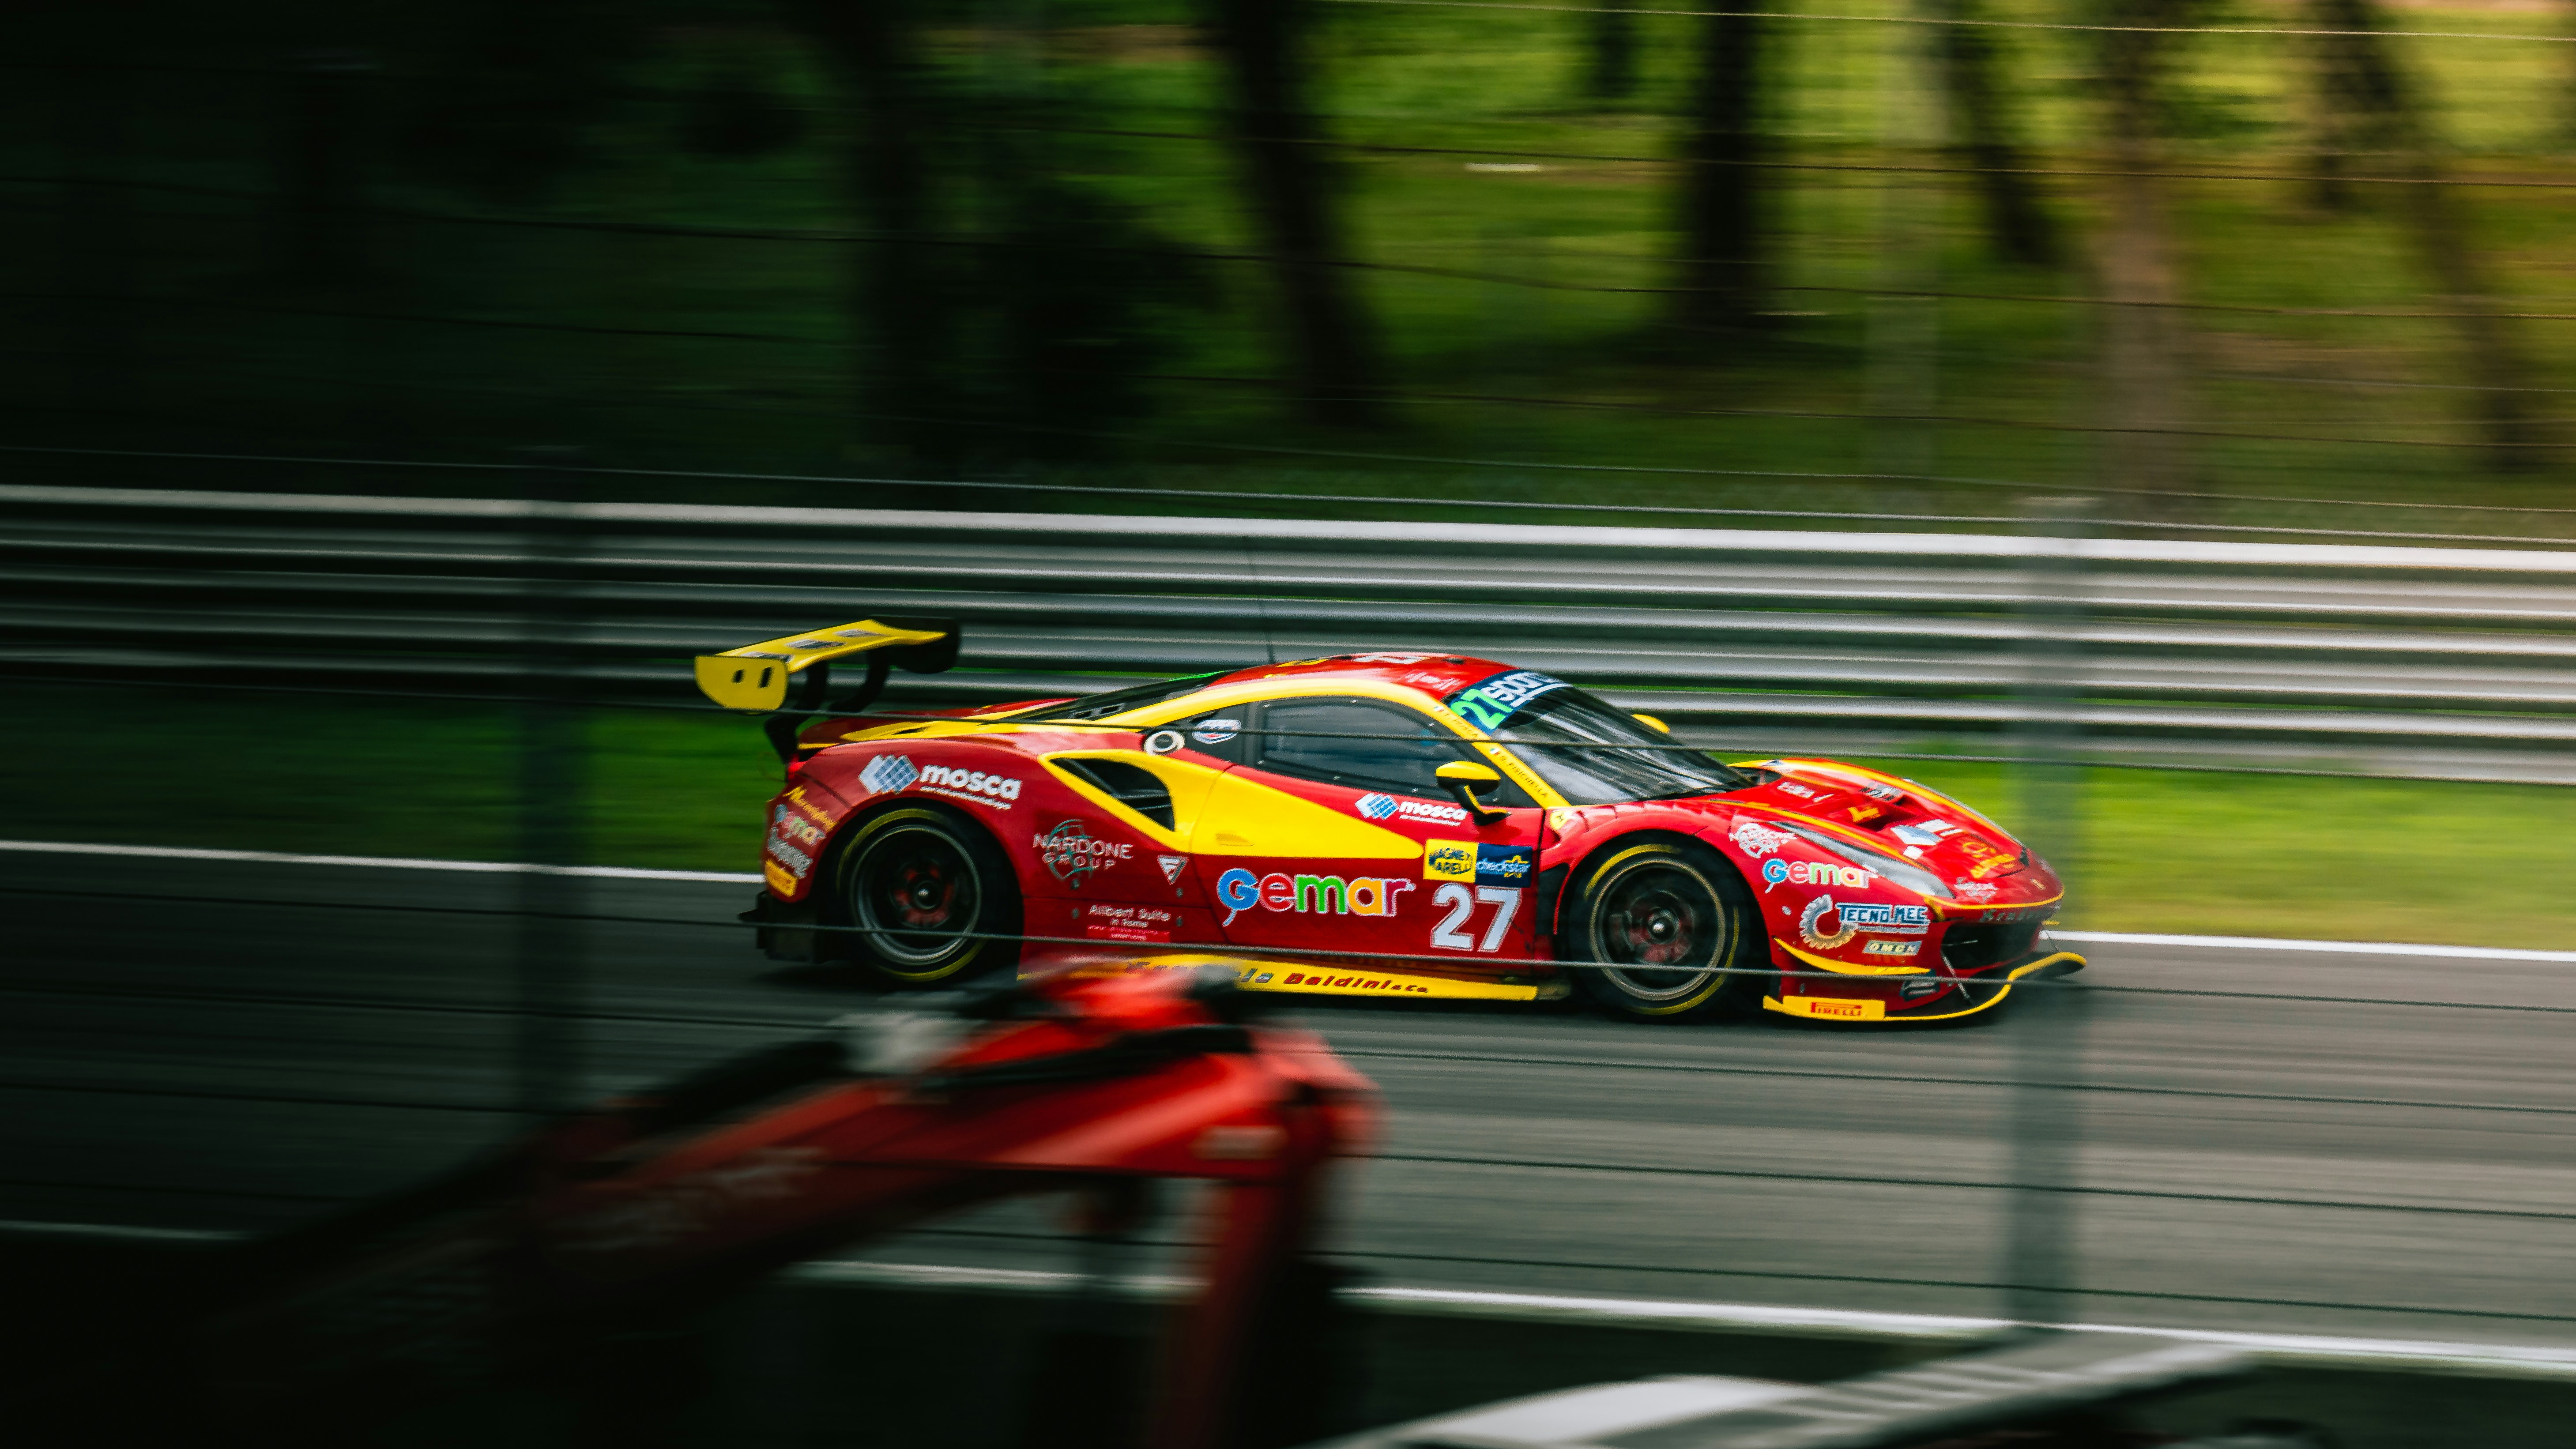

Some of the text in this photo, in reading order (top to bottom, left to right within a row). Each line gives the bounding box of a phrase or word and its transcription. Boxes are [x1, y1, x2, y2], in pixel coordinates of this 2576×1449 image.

[1450, 689, 1514, 730] 27
[918, 764, 1023, 800] mosca
[1398, 801, 1469, 821] mosca
[1033, 832, 1134, 860] NARDONE
[1042, 851, 1116, 872] GROUP
[1762, 858, 1879, 893] Gemar
[1217, 868, 1416, 928] Gemar
[1430, 883, 1523, 952] 27
[1811, 1002, 1862, 1017] PIRELLI
